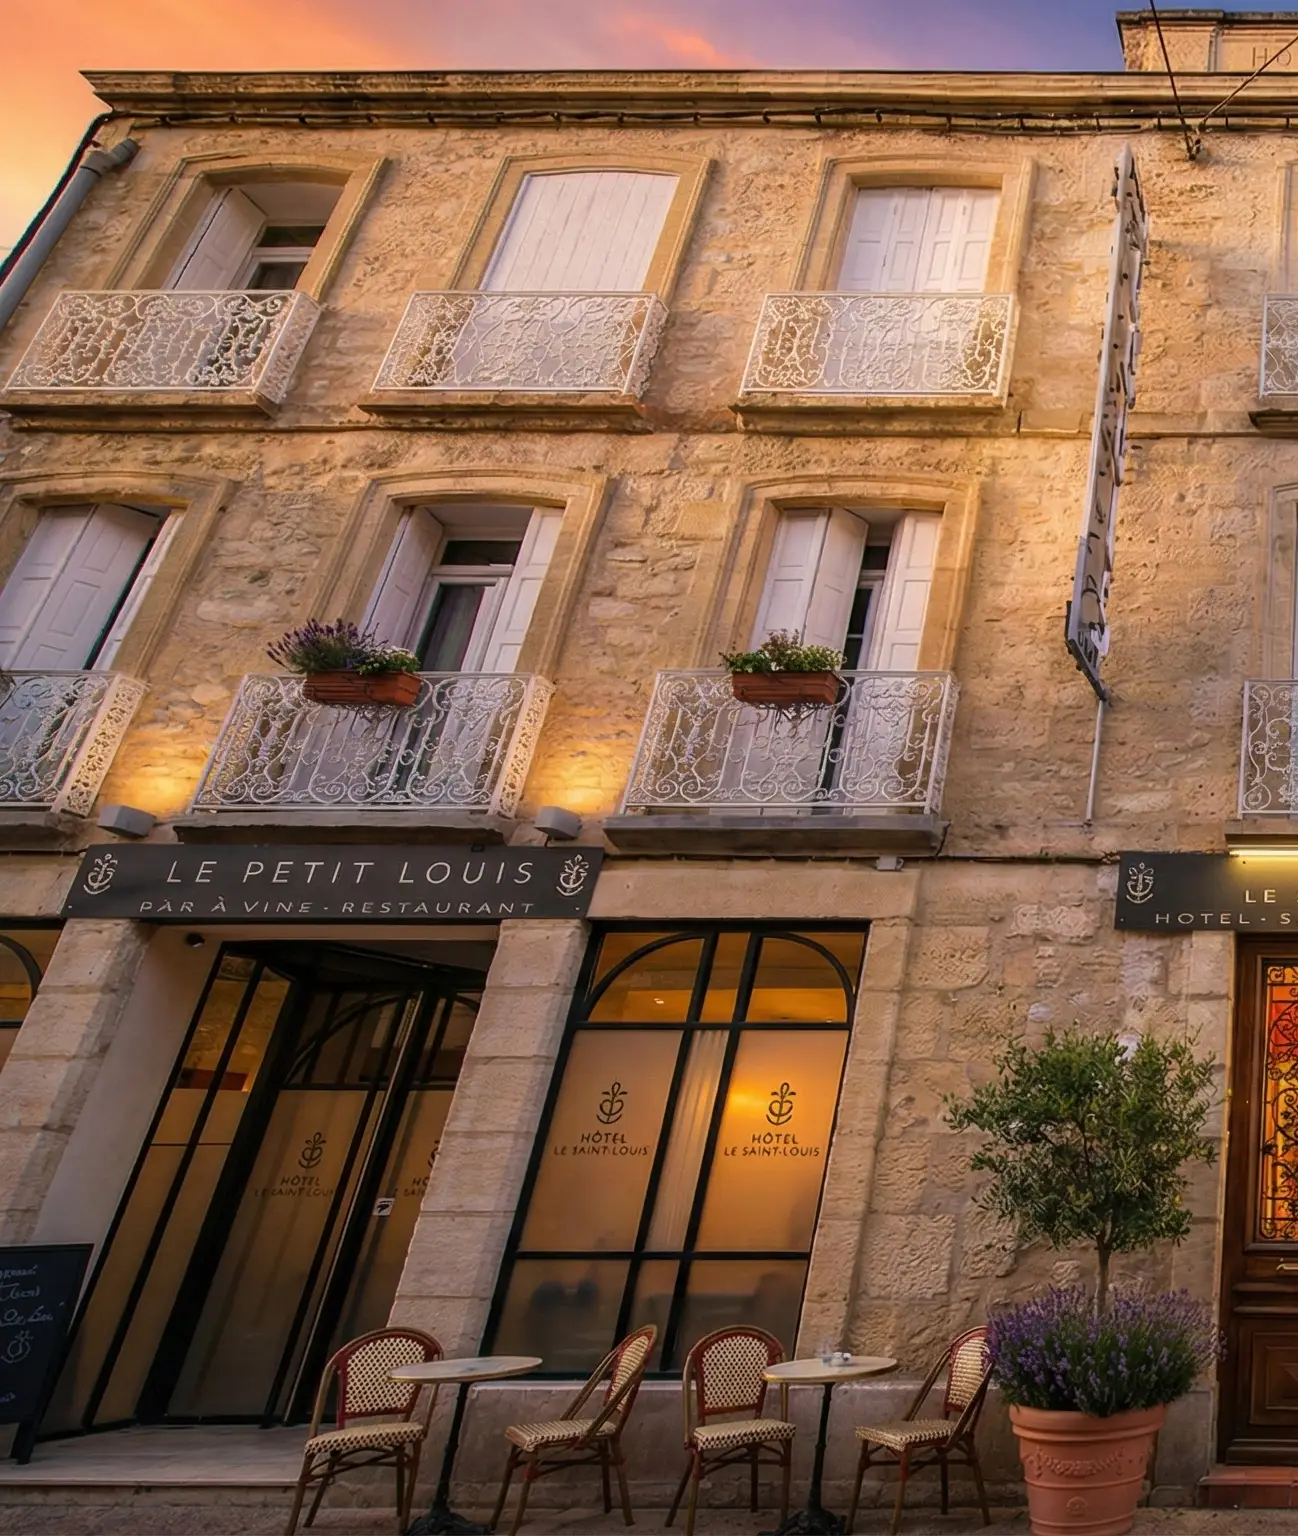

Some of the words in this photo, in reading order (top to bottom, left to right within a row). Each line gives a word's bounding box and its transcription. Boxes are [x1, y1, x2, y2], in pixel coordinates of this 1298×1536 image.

[166, 860, 217, 883] LE
[242, 860, 375, 884] PETIT
[398, 861, 534, 884] LOUIS
[1245, 889, 1276, 904] LE
[341, 901, 535, 914] RESTAURANT
[1155, 912, 1251, 925] HOTEL
[580, 1129, 628, 1144] HÔTEL
[752, 1131, 799, 1145] HÔTEL
[553, 1145, 568, 1156] LE
[723, 1146, 738, 1157] LE
